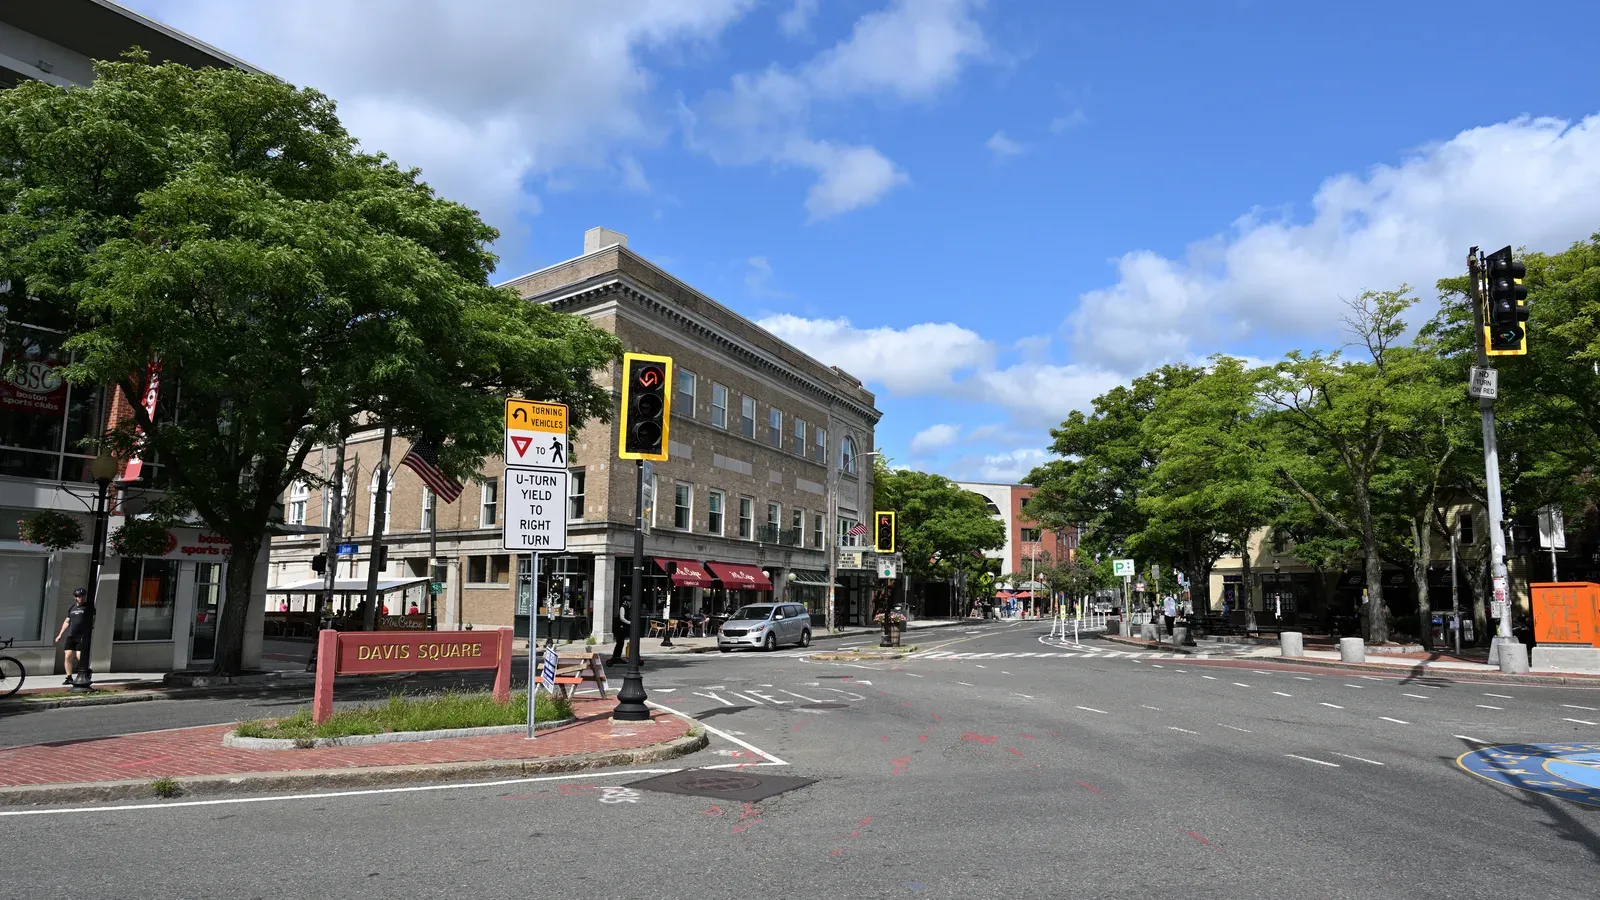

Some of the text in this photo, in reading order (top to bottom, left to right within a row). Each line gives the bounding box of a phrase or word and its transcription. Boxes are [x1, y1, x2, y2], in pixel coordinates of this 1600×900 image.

[16, 391, 47, 401] boston
[3, 397, 59, 410] sports clubs
[532, 406, 563, 416] TURNING
[531, 419, 563, 429] VEHICLES
[536, 447, 546, 455] TO
[516, 474, 557, 486] U-TURN
[521, 489, 552, 501] YIELD
[530, 505, 543, 515] TO
[520, 520, 551, 530] RIGHT
[198, 533, 231, 544] bosto
[522, 535, 550, 546] TURN
[181, 546, 220, 555] sports
[358, 643, 482, 661] DAVIS SQUARE
